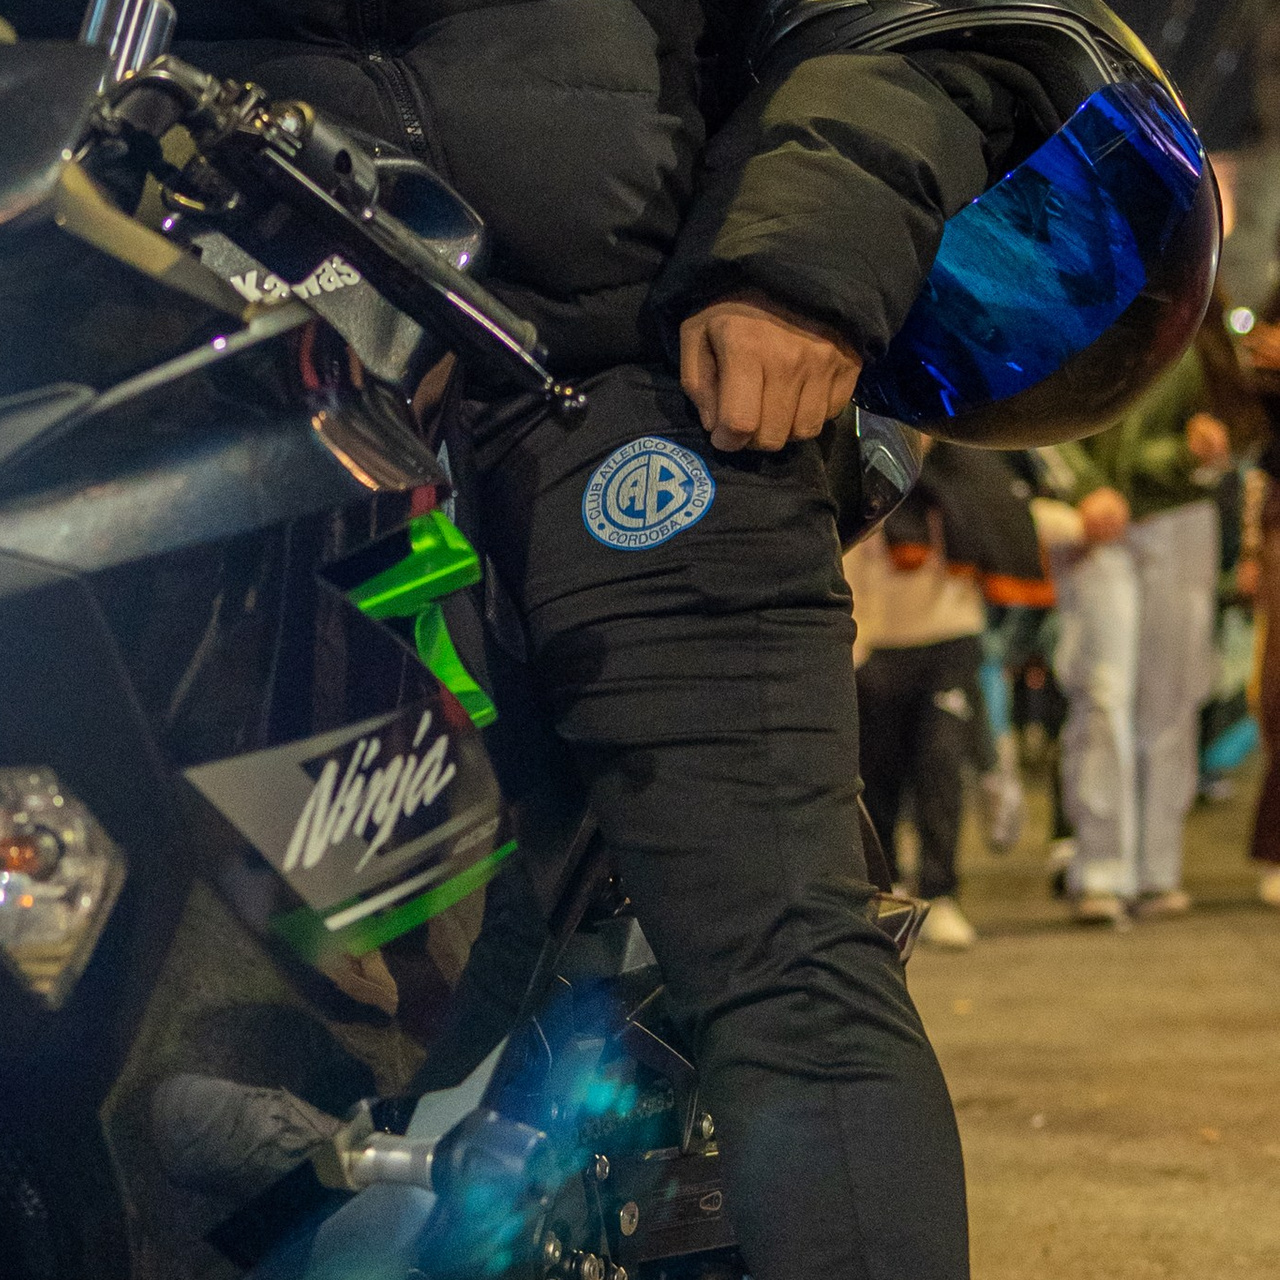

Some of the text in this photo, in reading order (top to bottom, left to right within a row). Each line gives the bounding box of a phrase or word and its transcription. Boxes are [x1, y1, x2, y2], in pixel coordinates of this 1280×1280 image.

[229, 255, 361, 304] Kawas
[588, 439, 709, 521] CLUB ATLETICO BELGRANO
[608, 520, 682, 547] CORDOBA
[282, 709, 457, 873] Ninja
